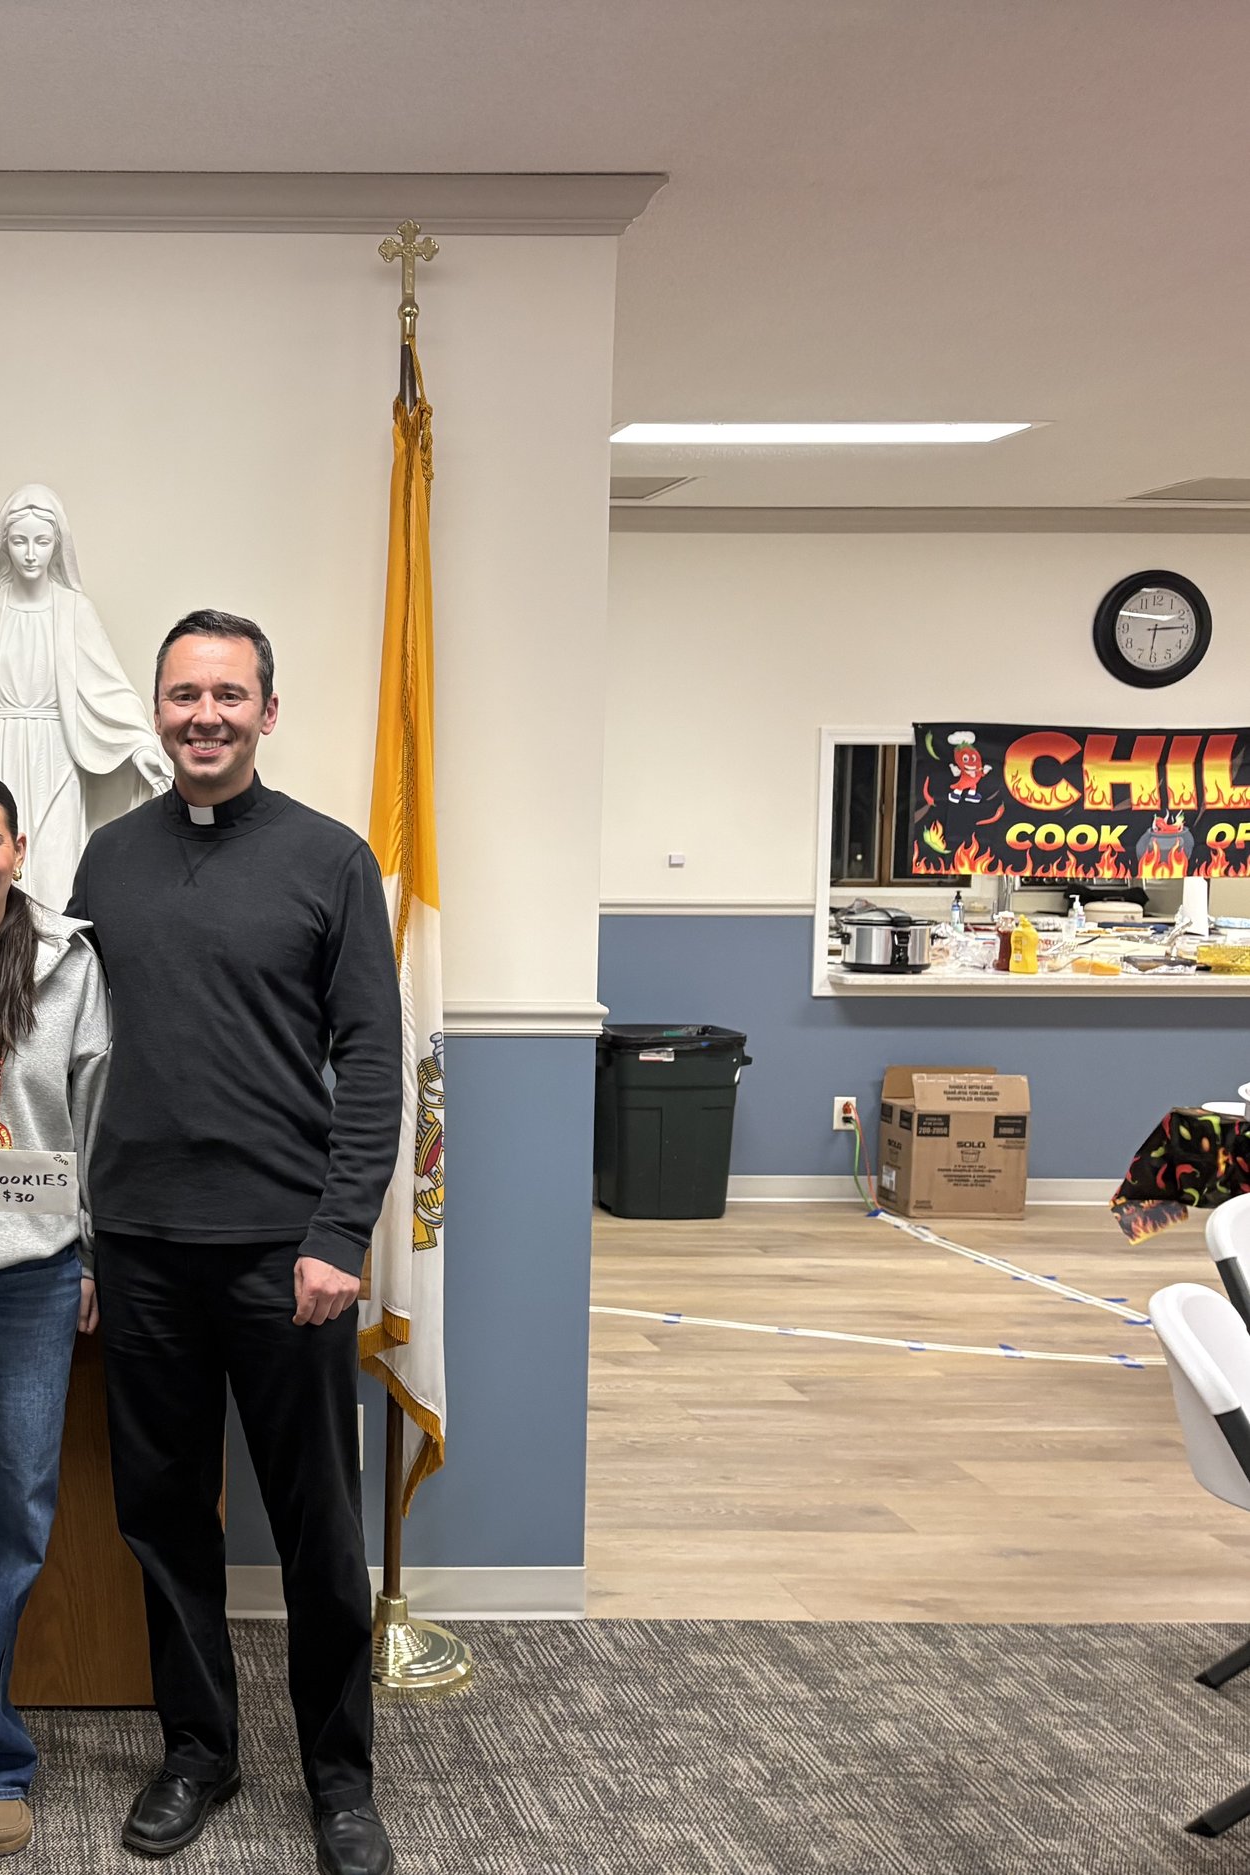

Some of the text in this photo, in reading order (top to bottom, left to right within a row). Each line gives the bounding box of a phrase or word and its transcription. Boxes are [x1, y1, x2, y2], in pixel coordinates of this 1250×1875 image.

[1140, 598, 1148, 610] 11
[1152, 595, 1164, 606] 12
[1178, 609, 1186, 620] 2
[1121, 623, 1129, 634] 9
[1182, 623, 1189, 635] 3
[1125, 637, 1133, 649] 8
[1175, 639, 1182, 650] 4
[1137, 648, 1145, 660] 7
[1149, 651, 1157, 664] 6
[1164, 648, 1172, 660] 5
[1003, 731, 1250, 811] CHIL
[1005, 822, 1129, 852] COOK
[956, 1141, 986, 1149] SOLO
[52, 1153, 69, 1166] 2ND
[2, 1189, 35, 1203] $30
